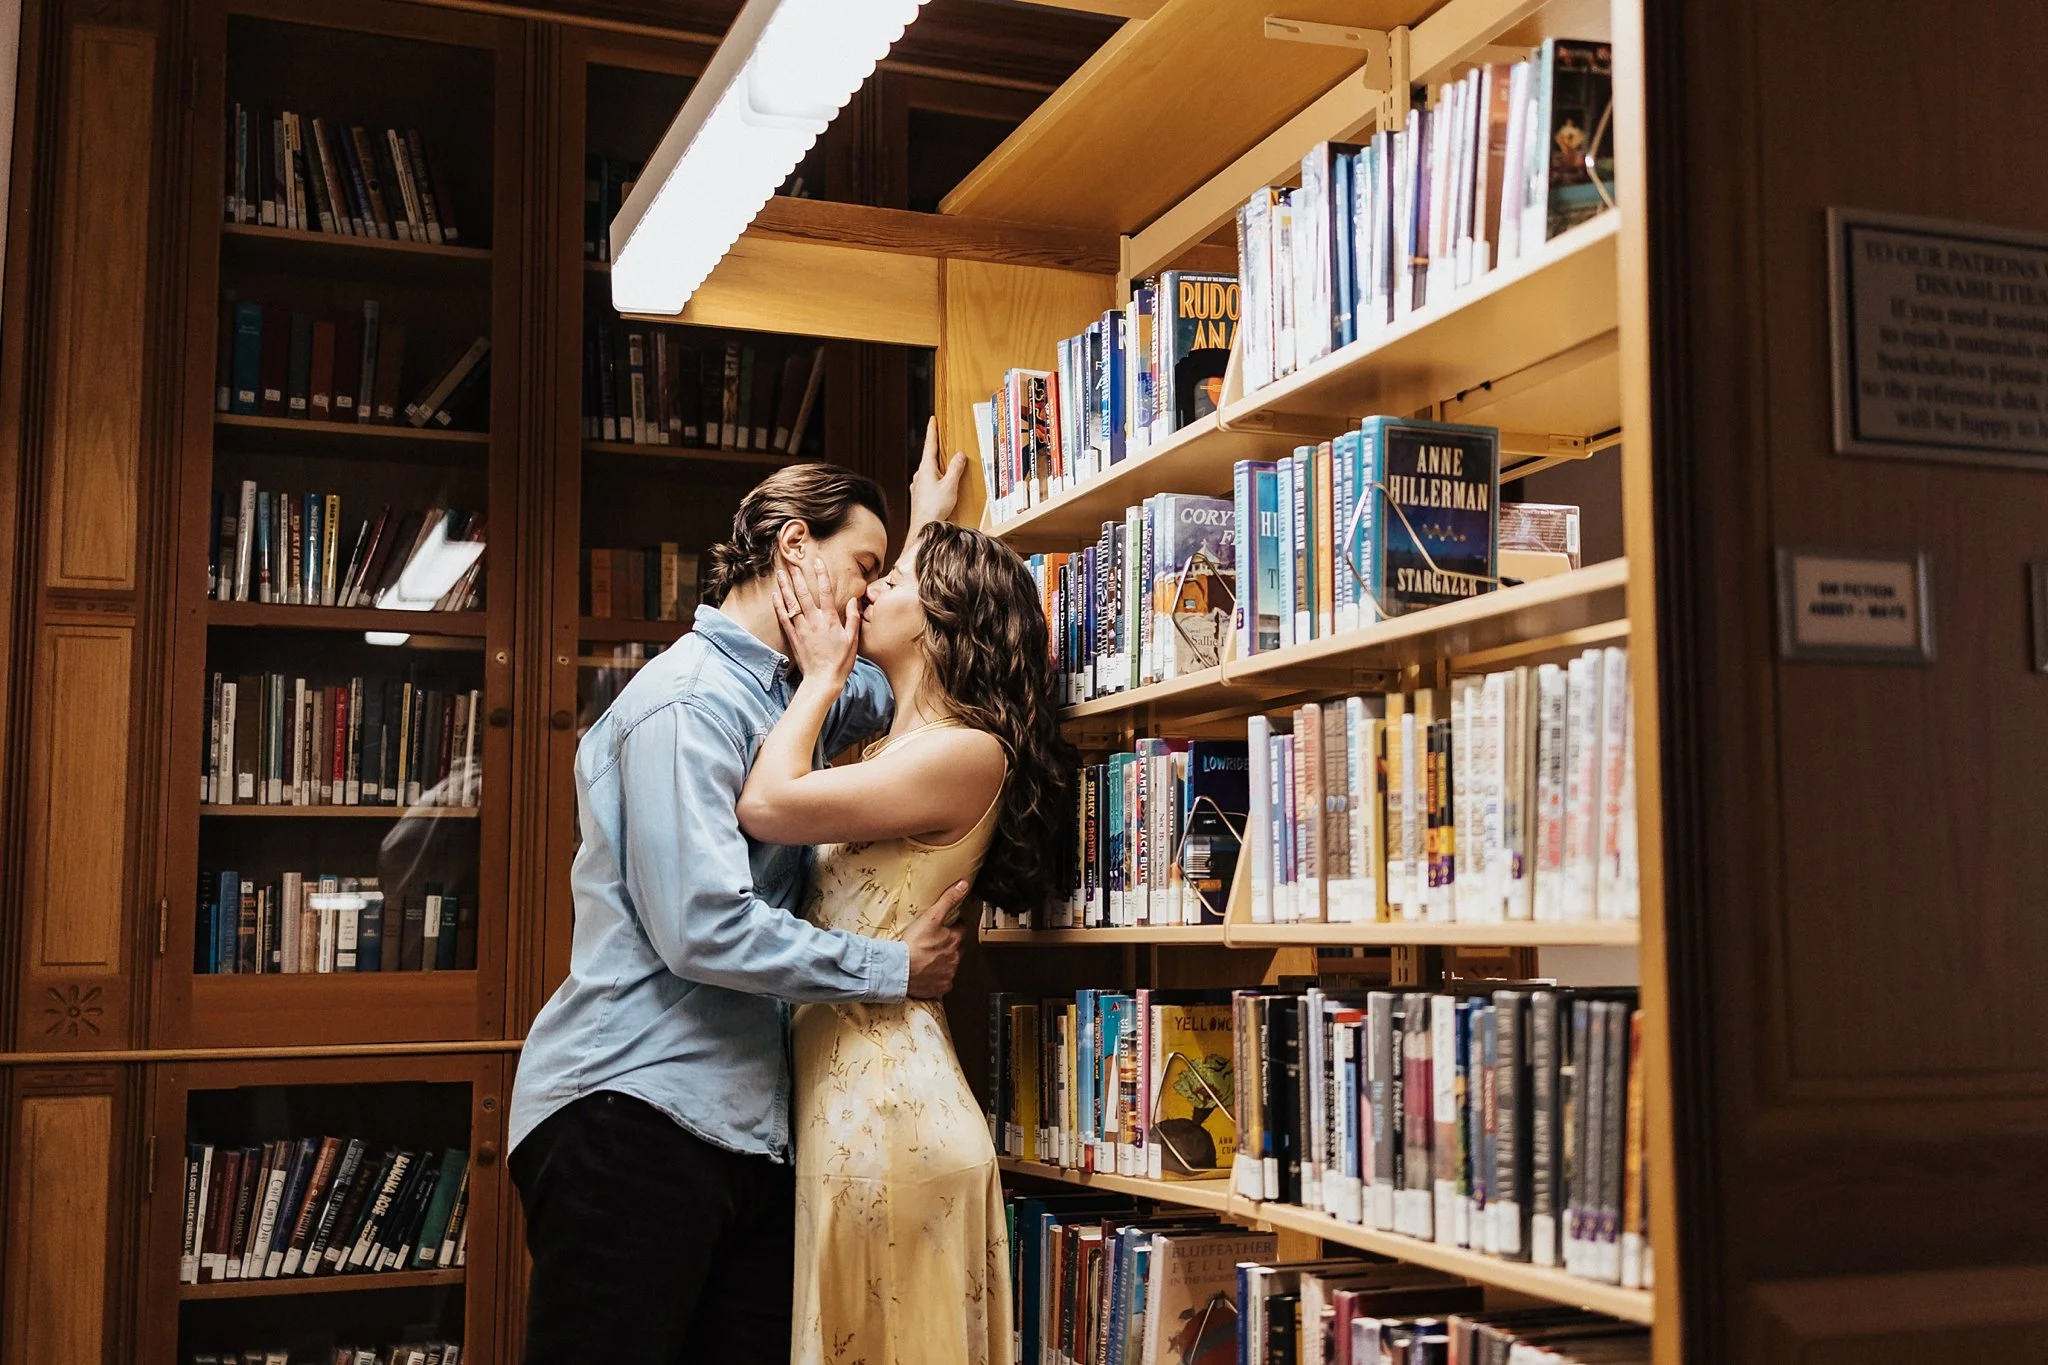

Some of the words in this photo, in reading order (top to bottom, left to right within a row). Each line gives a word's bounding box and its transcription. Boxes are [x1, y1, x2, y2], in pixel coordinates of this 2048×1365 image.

[1417, 445, 1464, 476] ANNE
[1390, 475, 1488, 511] HILLERMAN
[1397, 567, 1478, 596] STARGAZER
[1158, 832, 1165, 843] By
[382, 1155, 410, 1194] BANANA
[240, 1186, 249, 1212] STONE
[372, 1194, 392, 1216] ROSE
[184, 1221, 193, 1248] FUNERAL
[235, 1213, 245, 1245] HORSES
